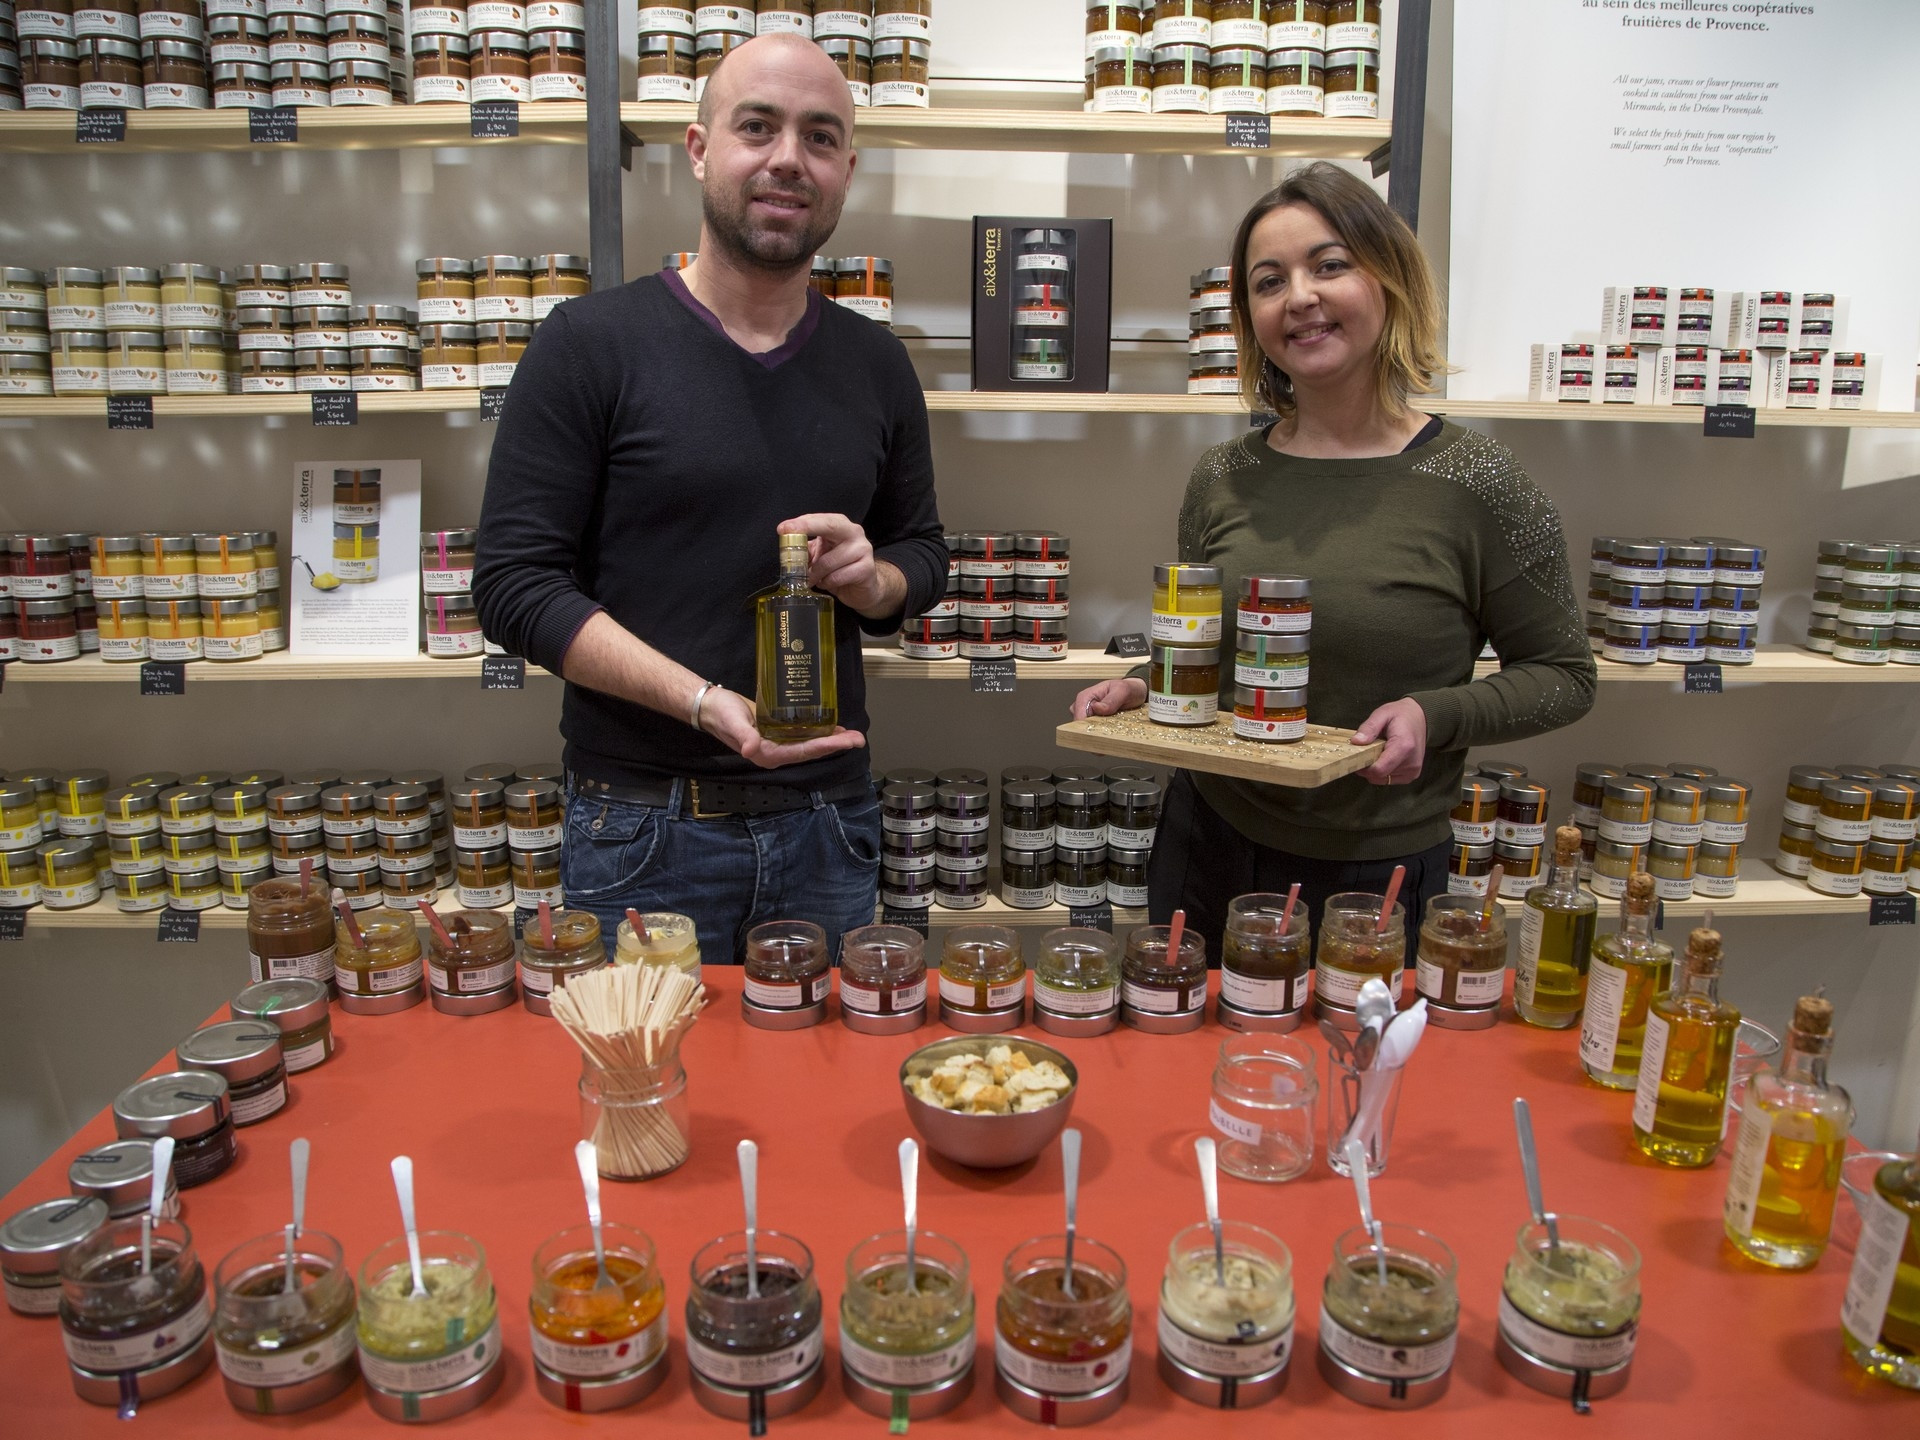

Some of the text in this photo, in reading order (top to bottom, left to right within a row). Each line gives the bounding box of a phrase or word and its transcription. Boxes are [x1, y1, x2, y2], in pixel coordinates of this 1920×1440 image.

[1583, 0, 1814, 16] au sein des meilleures coopératives
[1622, 15, 1770, 32] fruitières de Provence.
[1613, 75, 1628, 84] All
[1644, 77, 1666, 87] jams,
[1667, 78, 1693, 86] creams
[1704, 77, 1729, 89] flower
[1730, 80, 1765, 90] preserves
[1766, 81, 1779, 89] are
[1622, 88, 1768, 102] cooked in cauldrons from our atelier in
[1623, 101, 1666, 113] Mirmande,
[1669, 103, 1677, 112] in
[1679, 103, 1691, 112] the
[1613, 126, 1776, 143] We select the fresh fruits from our region by
[1610, 141, 1631, 150] small
[1631, 141, 1662, 152] farmers
[1664, 142, 1679, 151] and
[1680, 142, 1689, 151] in
[1690, 143, 1703, 152] the
[1704, 143, 1720, 152] best
[1664, 155, 1721, 167] from Provence.
[983, 228, 996, 297] aix&terra
[846, 298, 879, 306] aix&terra
[1617, 294, 1627, 335] aix&terra
[1744, 298, 1754, 339] aix&terra
[1546, 351, 1556, 392] aix&terra
[1660, 355, 1669, 396] aix&terra
[1774, 359, 1783, 400] aix&terra
[300, 469, 310, 523] aix&terra
